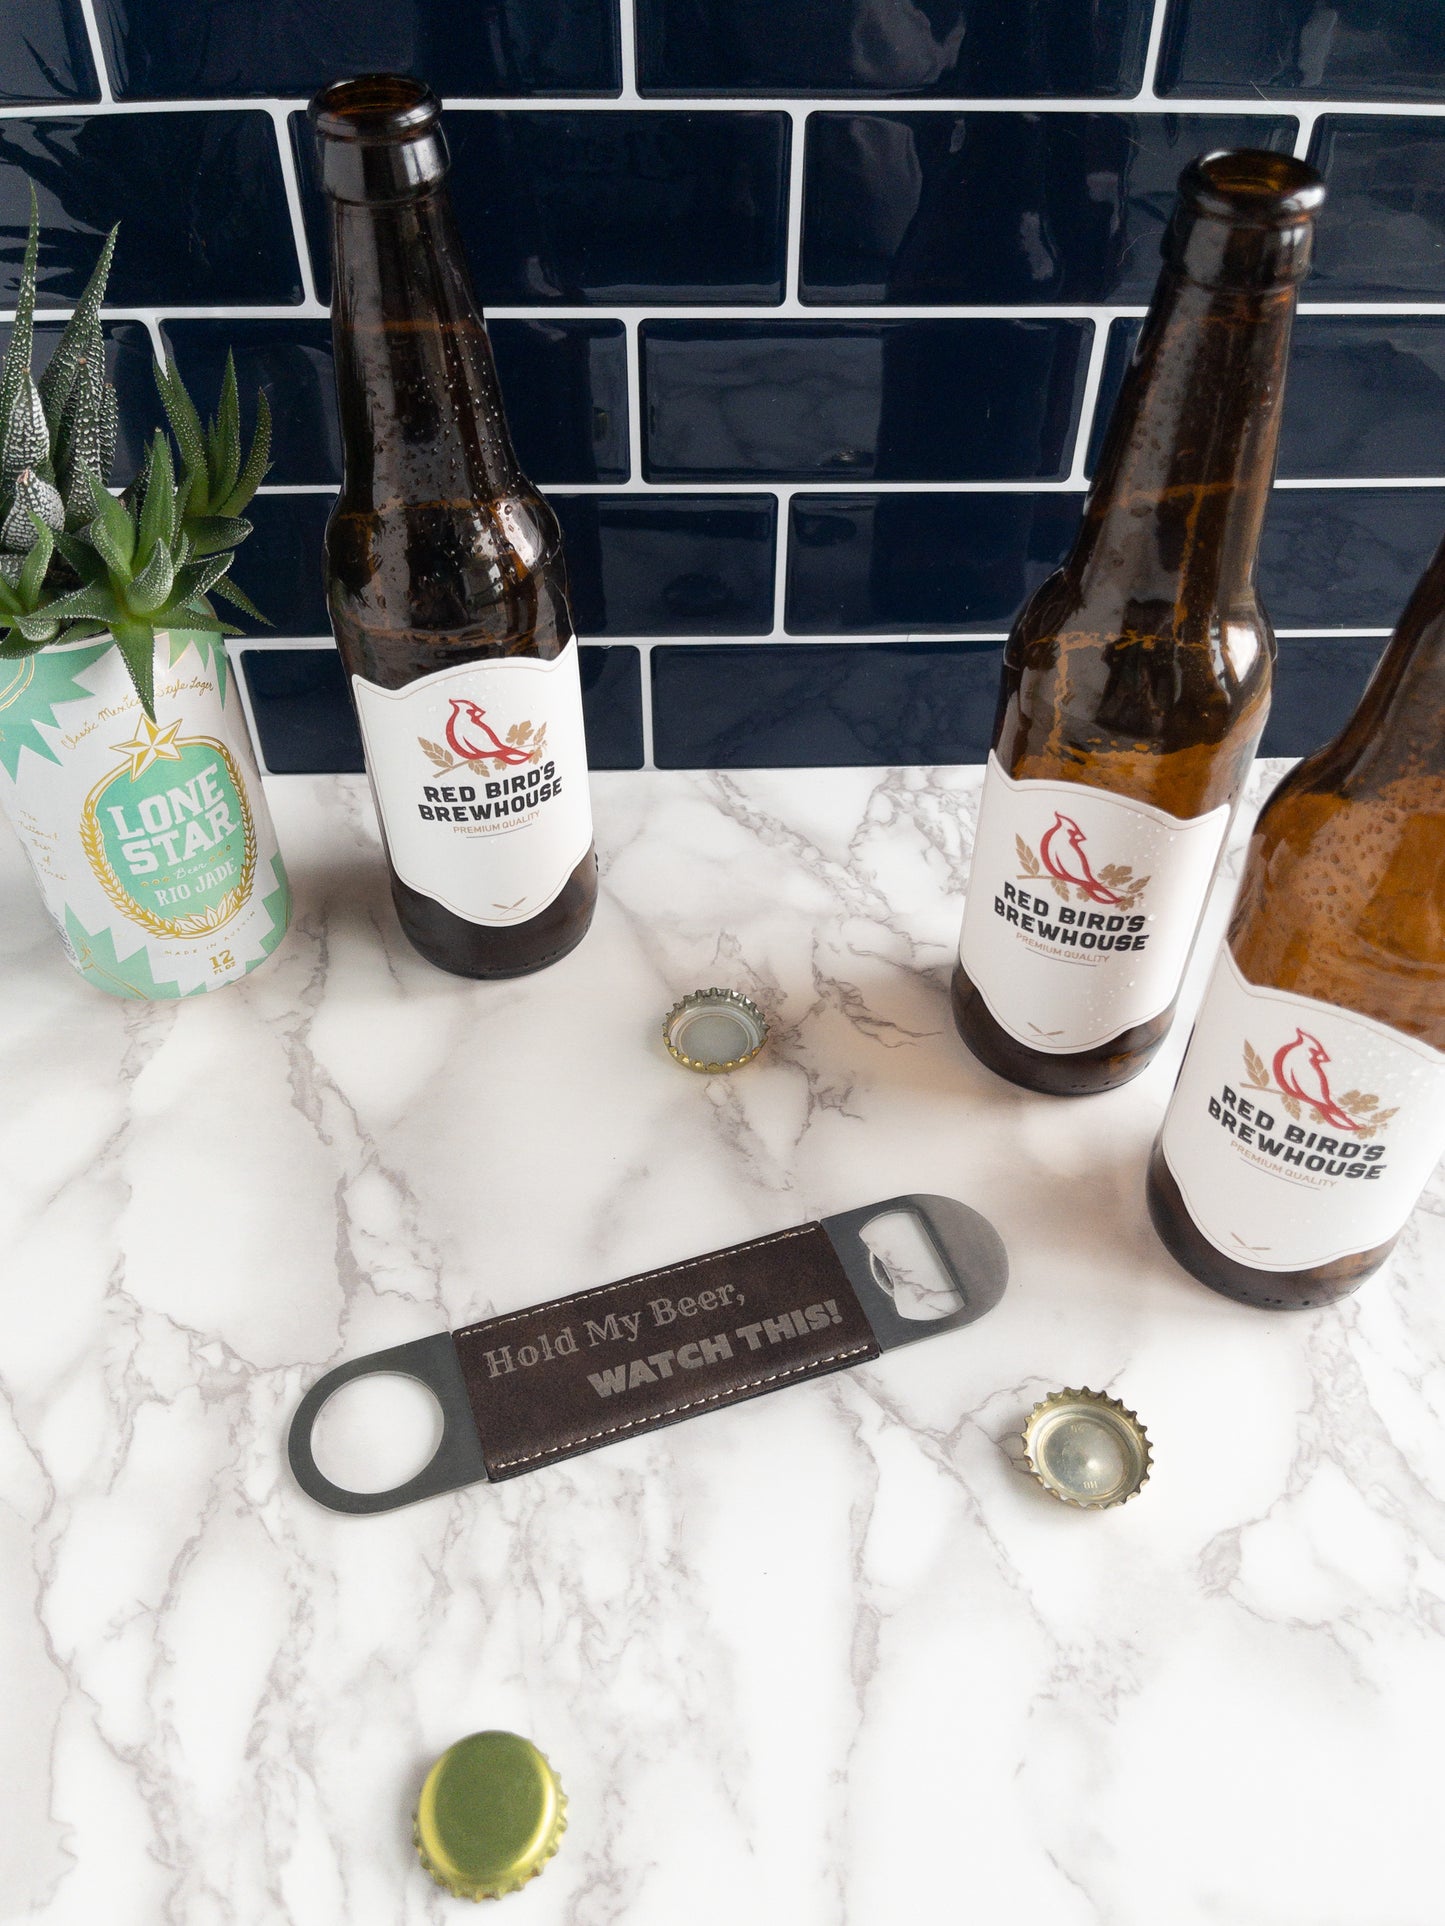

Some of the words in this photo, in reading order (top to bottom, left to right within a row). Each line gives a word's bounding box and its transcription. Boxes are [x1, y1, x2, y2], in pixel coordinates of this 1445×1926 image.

[98, 694, 143, 722] Mexica
[189, 676, 214, 696] Lager
[107, 763, 225, 840] LONE
[418, 777, 562, 822] BREWHOUSE
[423, 786, 476, 803] RED
[485, 760, 556, 800] BIRD'S
[121, 801, 237, 875] STAR
[453, 823, 501, 834] PREMIUM
[502, 810, 541, 829] QUALITY
[154, 883, 192, 907] RIO
[195, 857, 238, 894] JADE
[175, 862, 207, 880] Beer
[994, 895, 1150, 951] BREWHOUSE
[1004, 881, 1049, 917] RED
[1058, 906, 1146, 933] BIRD'S
[209, 949, 234, 970] 12
[213, 967, 224, 976] FL
[1016, 932, 1062, 956] PREMIUM
[1064, 950, 1110, 964] QUALITY
[1208, 1096, 1387, 1180] BREWHOUSE
[1221, 1084, 1275, 1132] RED
[1283, 1123, 1386, 1162] BIRD'S
[1230, 1140, 1283, 1173] PREMIUM
[1285, 1170, 1338, 1188] QUALITY
[482, 1326, 580, 1378] Hold
[582, 1310, 643, 1349] My
[647, 1281, 746, 1329] Beer,
[586, 1334, 734, 1399] WATCH
[735, 1299, 844, 1351] THIS!
